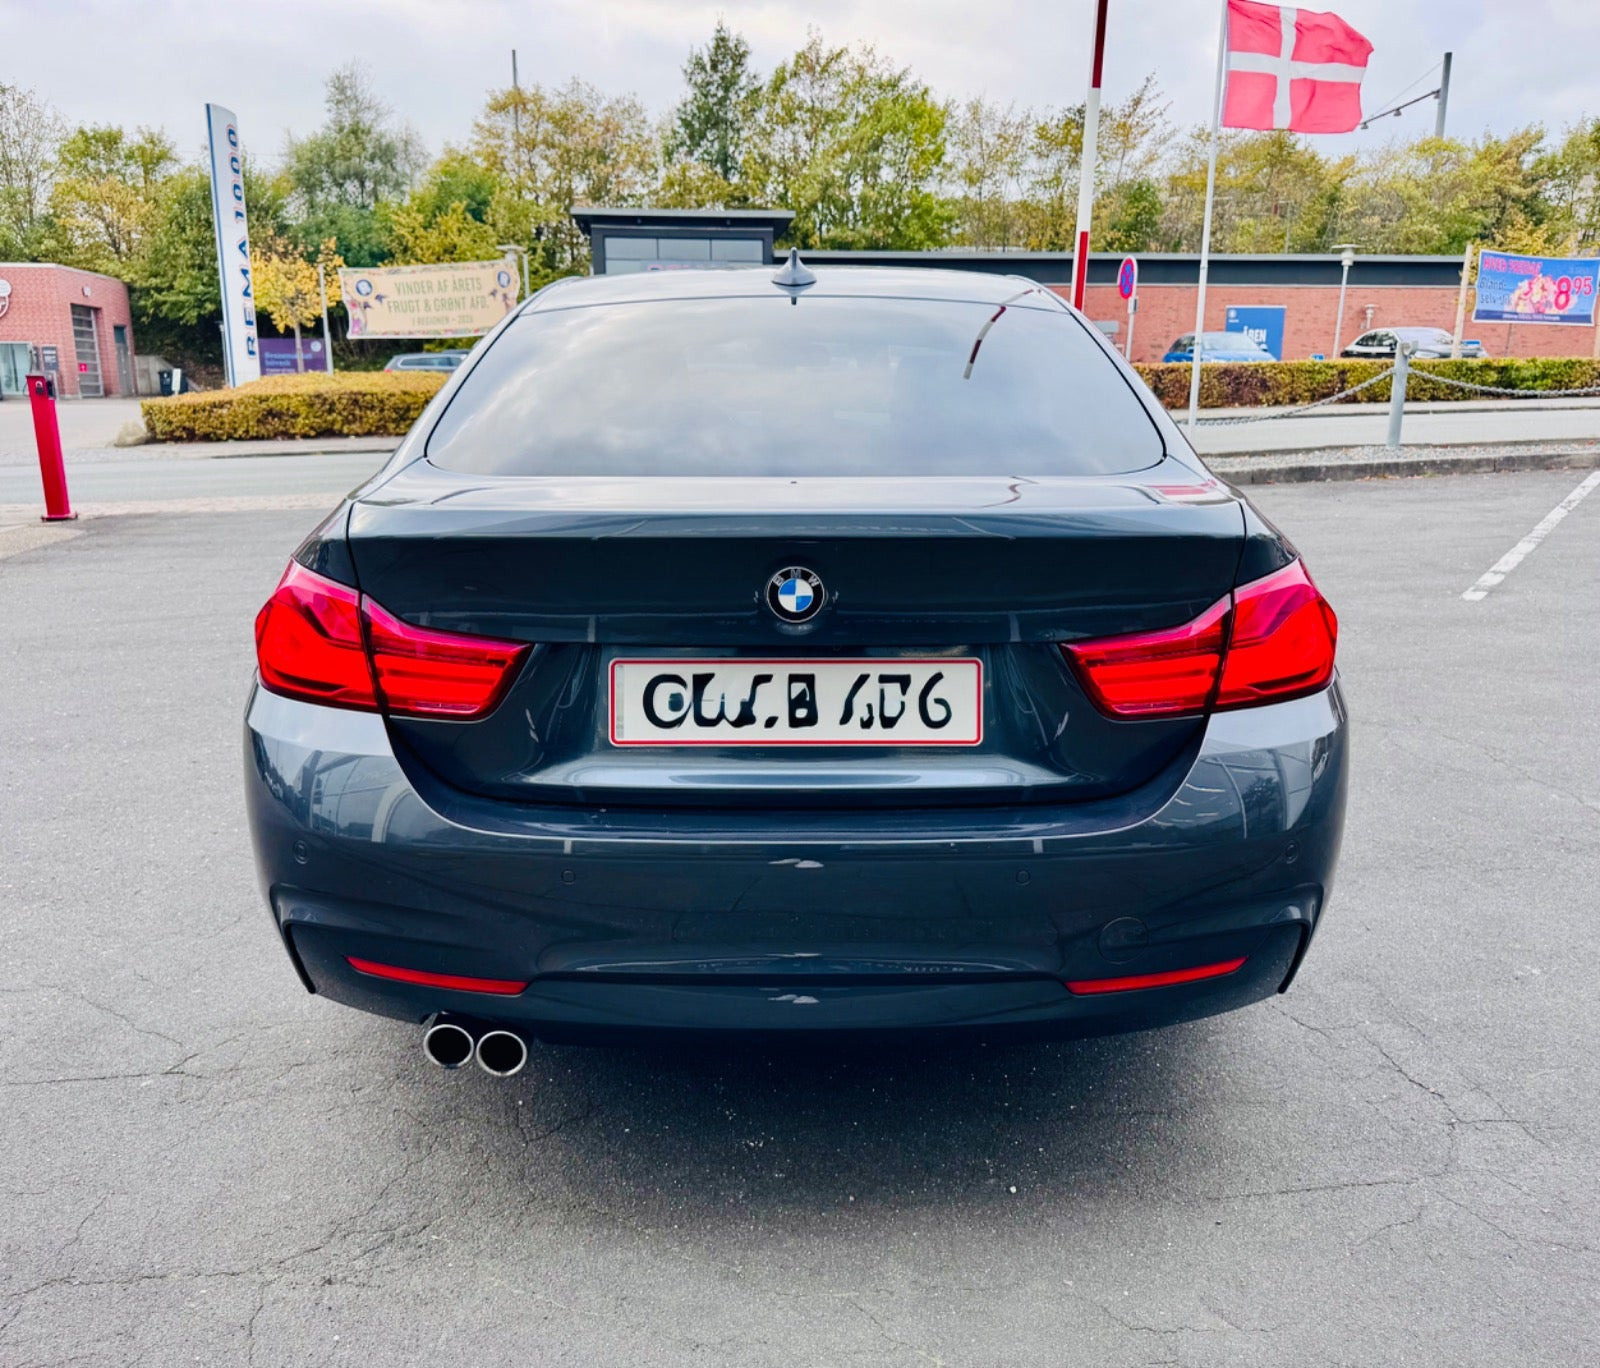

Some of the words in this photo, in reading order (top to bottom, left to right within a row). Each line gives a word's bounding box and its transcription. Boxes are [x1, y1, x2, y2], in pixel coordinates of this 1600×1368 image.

[226, 123, 244, 224] 1000
[394, 280, 433, 296] VINDER
[437, 279, 450, 293] AF
[452, 274, 483, 292] ÅRETS
[237, 235, 257, 359] REMA
[387, 299, 421, 314] FRUGT
[424, 299, 432, 312] &
[433, 297, 467, 312] GRØNT
[772, 569, 820, 588] BMW
